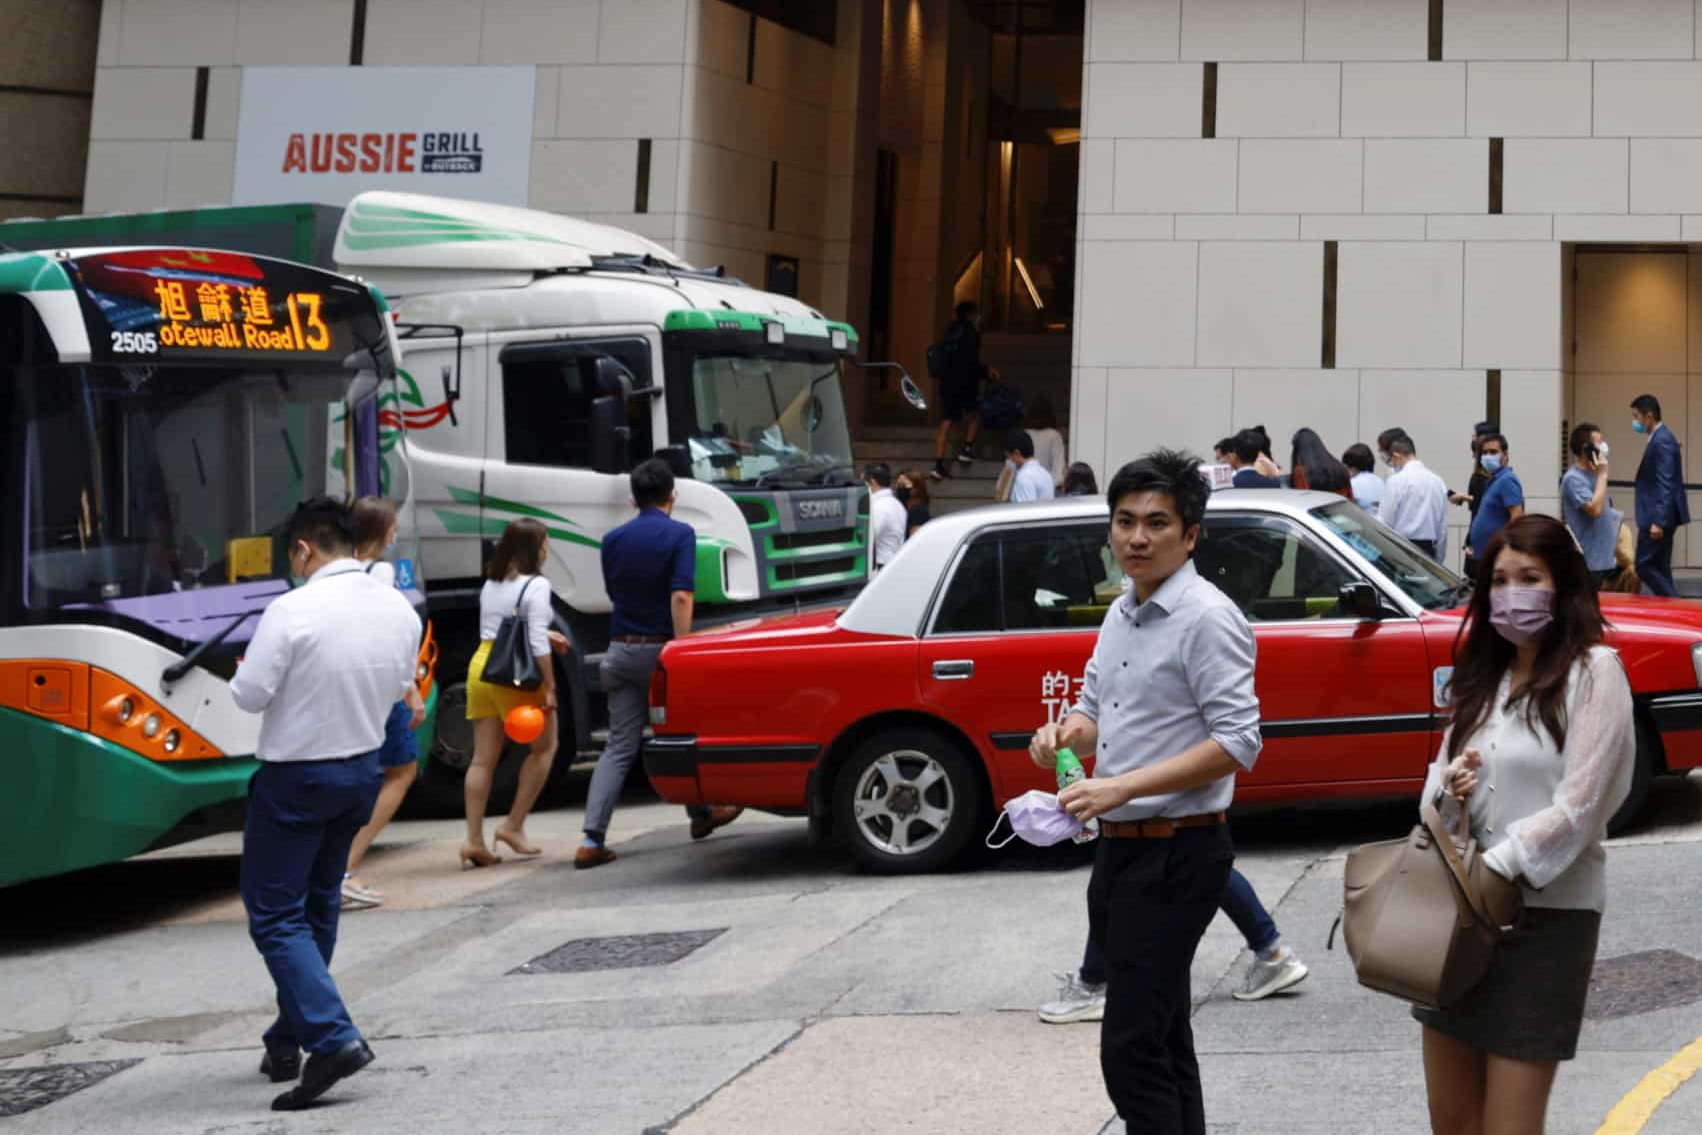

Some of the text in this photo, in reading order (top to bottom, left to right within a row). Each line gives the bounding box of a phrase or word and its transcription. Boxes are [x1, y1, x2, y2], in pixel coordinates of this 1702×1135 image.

[281, 132, 483, 174] AUSSIE GRILL
[159, 321, 295, 350] otewall Road
[287, 292, 330, 351] 13
[111, 331, 158, 354] 2505
[1041, 698, 1070, 726] TA
